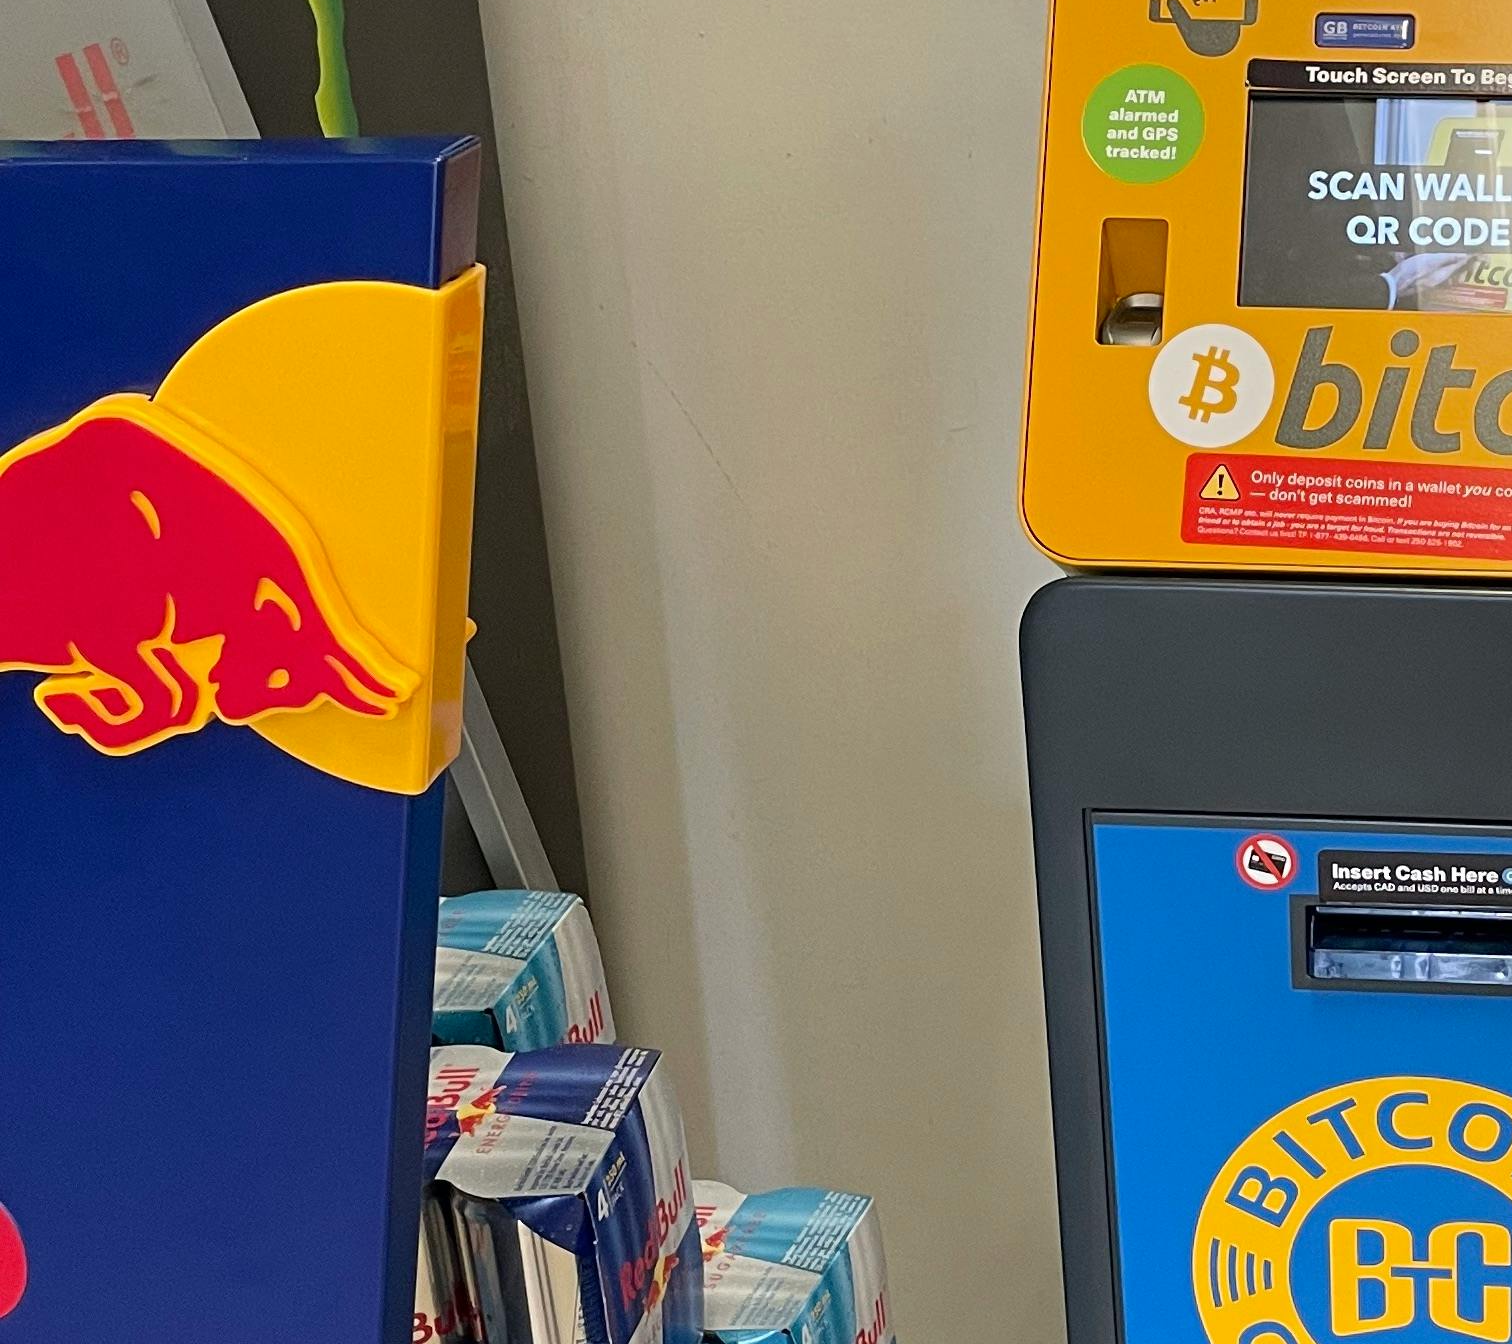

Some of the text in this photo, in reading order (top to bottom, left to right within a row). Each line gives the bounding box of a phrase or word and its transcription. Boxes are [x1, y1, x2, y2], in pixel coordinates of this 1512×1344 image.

[1305, 66, 1368, 85] Touch
[1372, 68, 1447, 85] Screen
[1450, 69, 1476, 85] To
[1125, 90, 1165, 104] ATM
[1108, 109, 1179, 123] alarmed
[1106, 127, 1178, 141] and GPS
[1105, 146, 1177, 160] tracked!
[1308, 170, 1405, 202] SCAN
[1346, 216, 1511, 247] QR CODE
[1251, 470, 1284, 486] Only
[1288, 473, 1342, 490] deposit
[1345, 476, 1384, 490] coins
[1388, 479, 1402, 491] in
[1417, 479, 1461, 494] wallet
[1464, 484, 1492, 498] you
[1269, 487, 1412, 508] don't get scammed!
[1333, 864, 1499, 883] Insert Cash Here
[1333, 882, 1372, 893] Accepts
[1374, 883, 1396, 892] CAD
[1398, 884, 1415, 893] and
[1418, 885, 1439, 893] USD
[1460, 885, 1475, 894] bill
[658, 1160, 686, 1244] Bull
